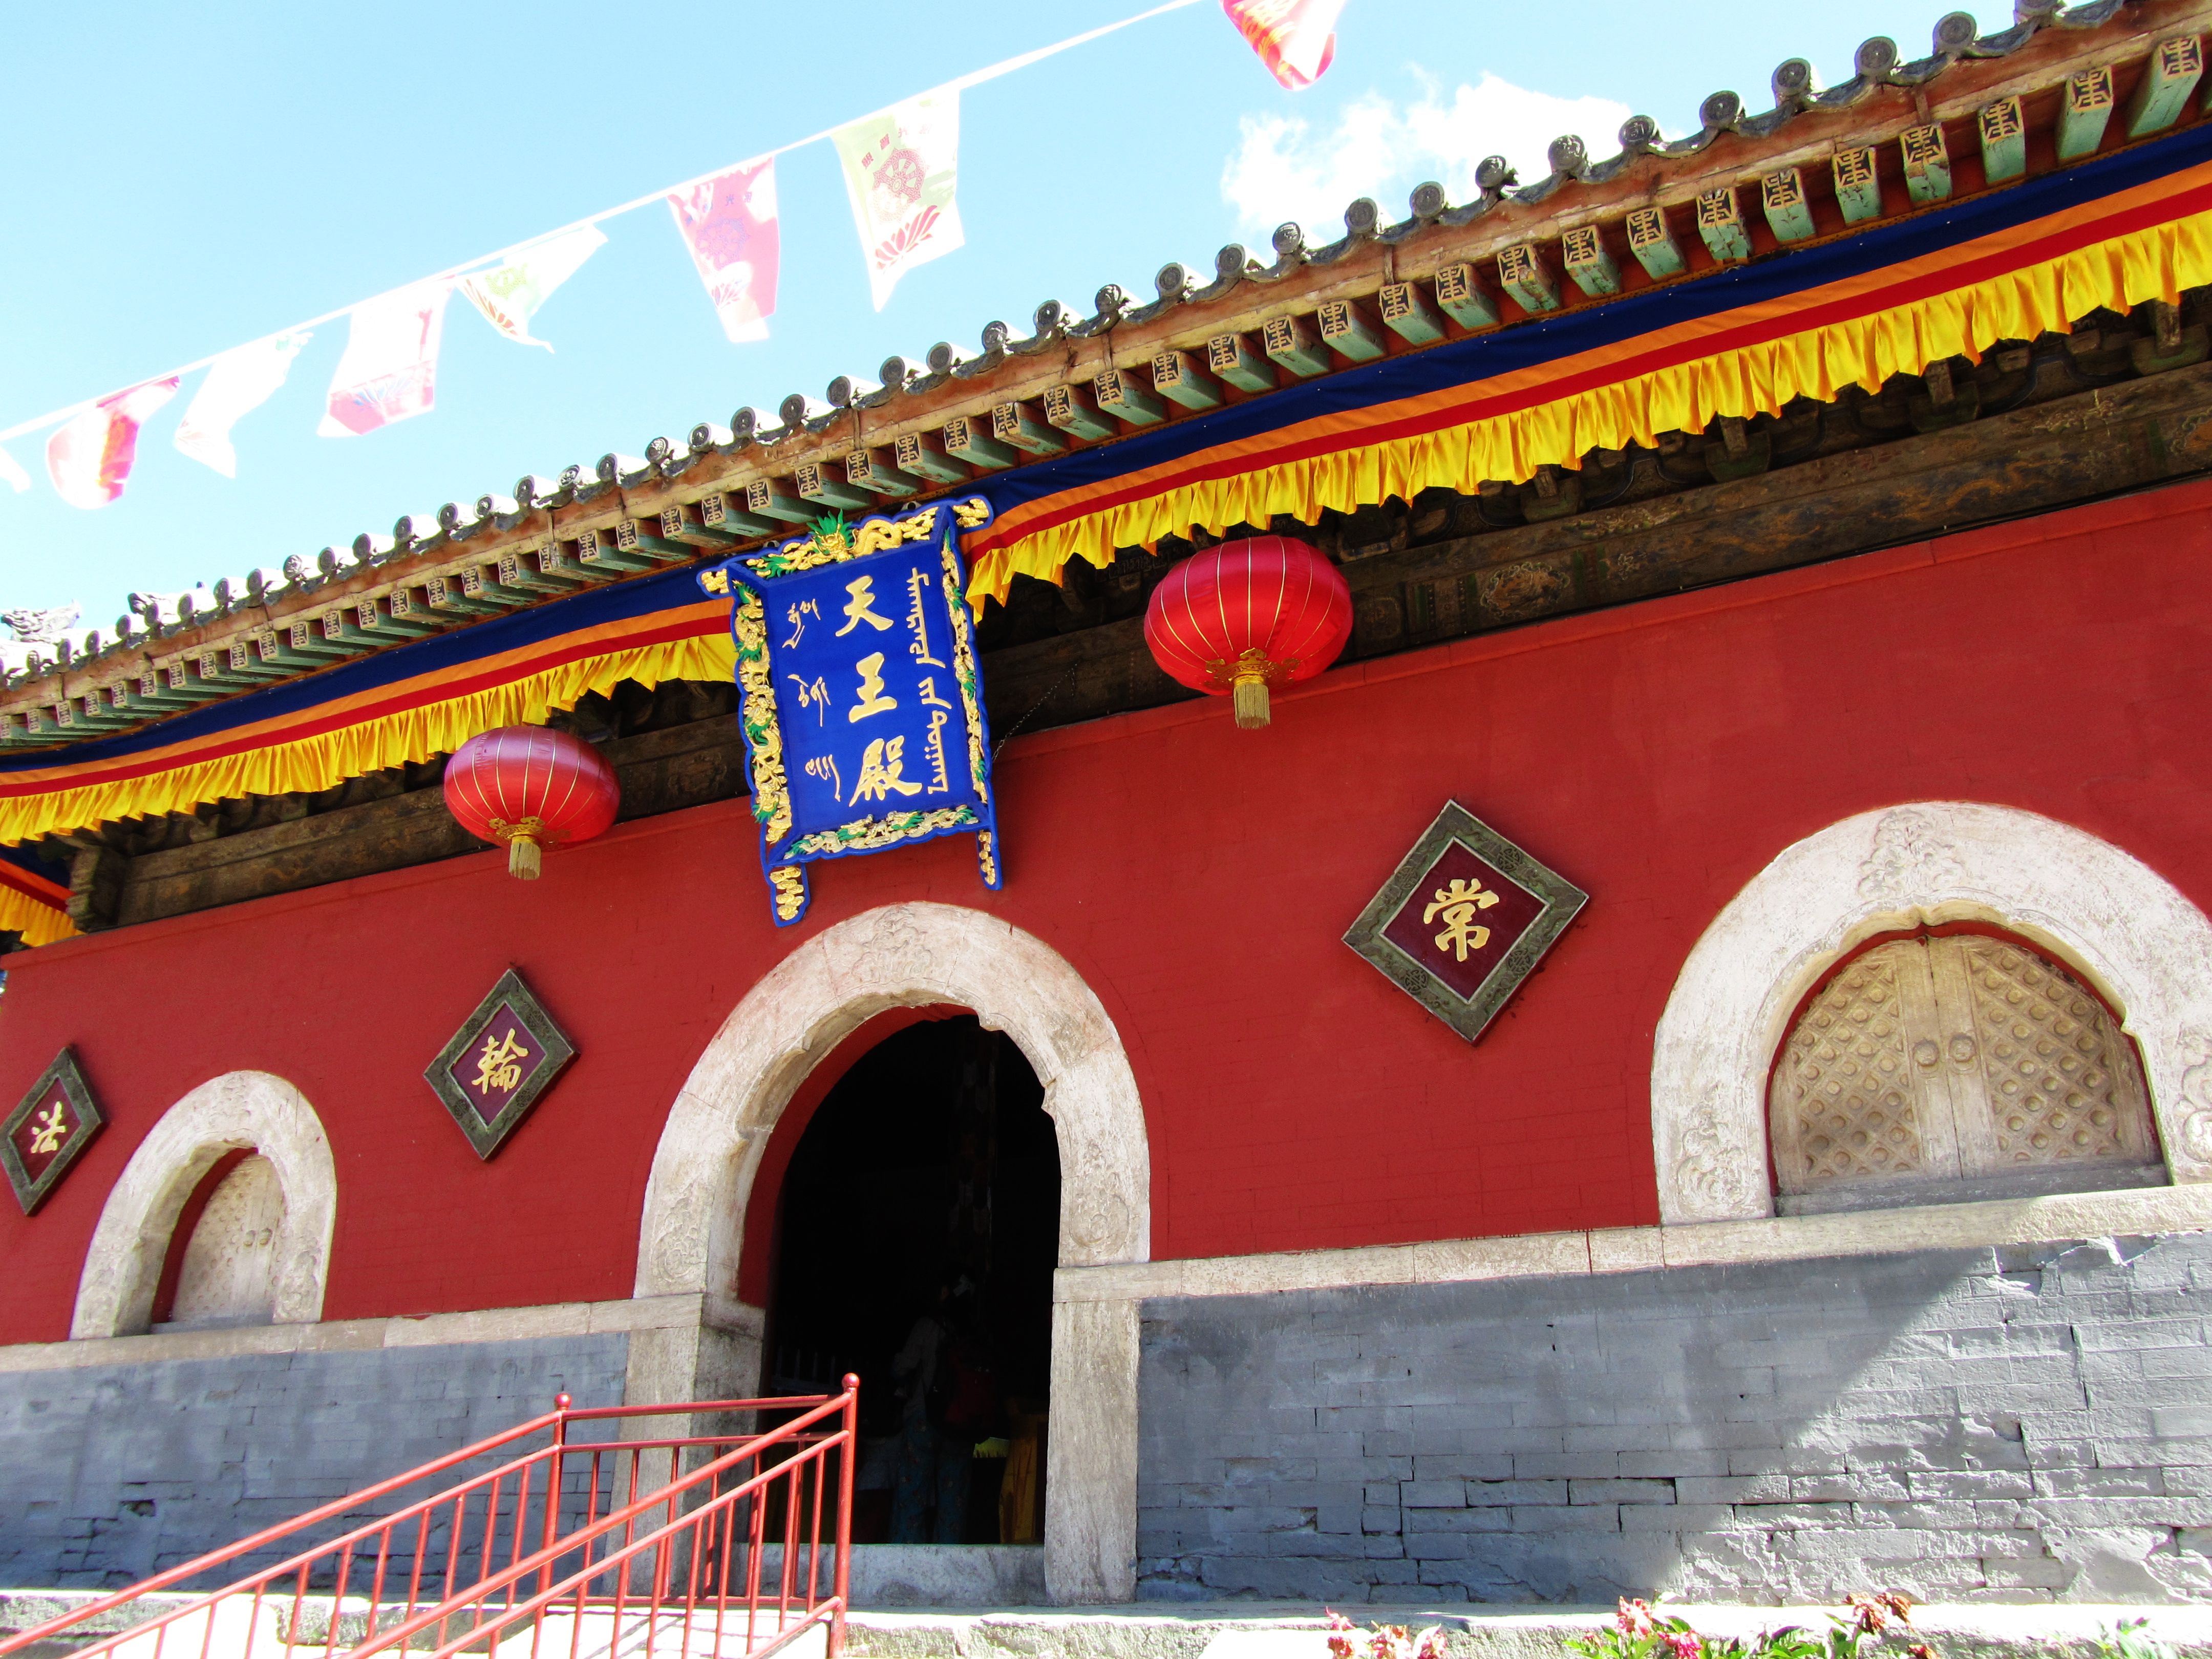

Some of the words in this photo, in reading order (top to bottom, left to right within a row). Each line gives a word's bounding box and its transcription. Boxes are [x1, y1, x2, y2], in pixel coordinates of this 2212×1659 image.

[836, 575, 922, 807] 天王殿
[1423, 878, 1500, 962] 常
[472, 1028, 529, 1095] 輪
[31, 1101, 67, 1153] 法
